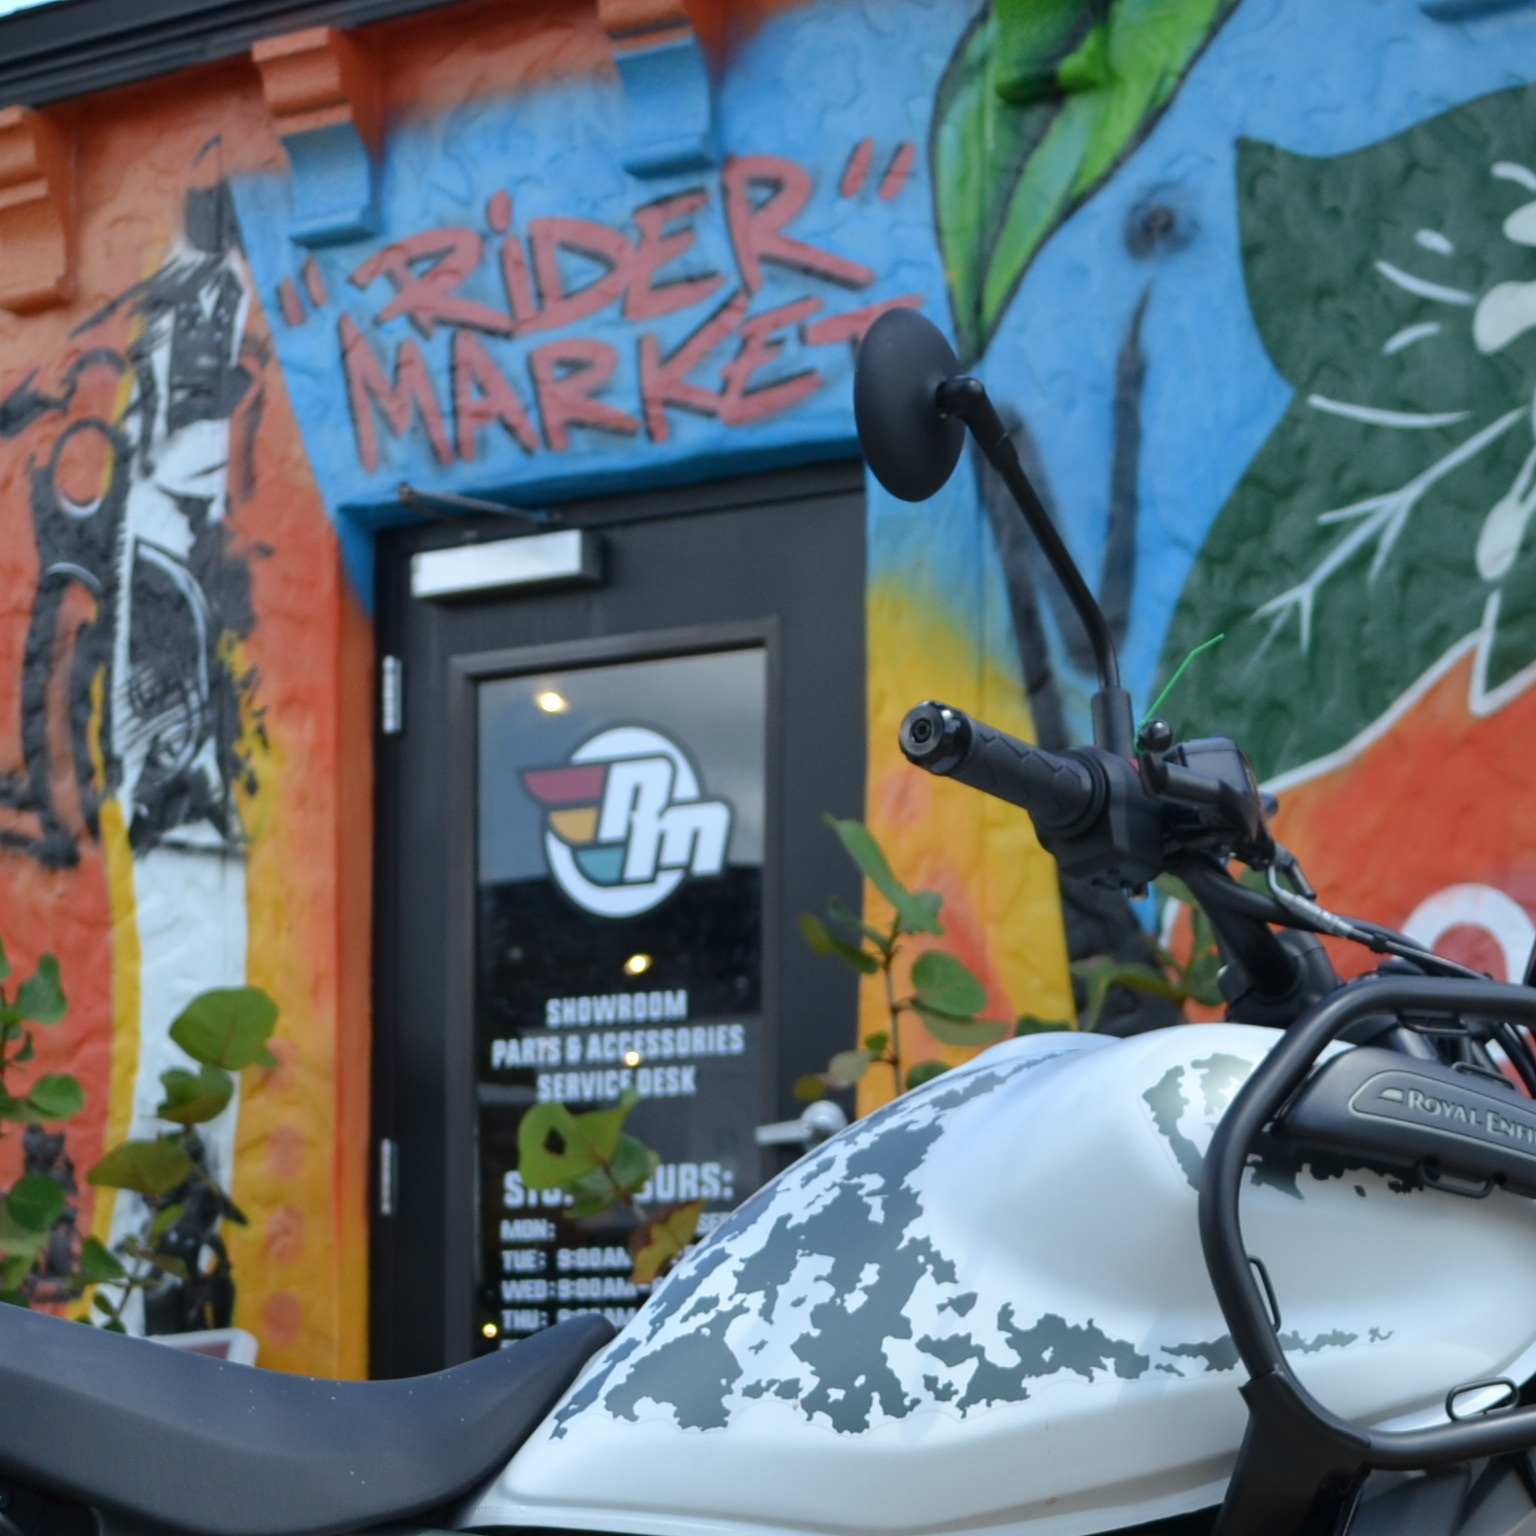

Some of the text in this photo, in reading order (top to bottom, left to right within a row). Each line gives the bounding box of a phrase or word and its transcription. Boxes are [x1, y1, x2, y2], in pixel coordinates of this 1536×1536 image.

[546, 990, 687, 1026] SHOWROOM
[492, 1024, 745, 1069] PARTS & ACCESSORIES
[537, 1065, 697, 1101] SERVICE DESK
[1407, 1088, 1482, 1125] ROYAL
[500, 1219, 556, 1242] MON:
[501, 1250, 547, 1272] TUE:
[501, 1280, 555, 1302] WED:
[501, 1309, 548, 1330] THU:
